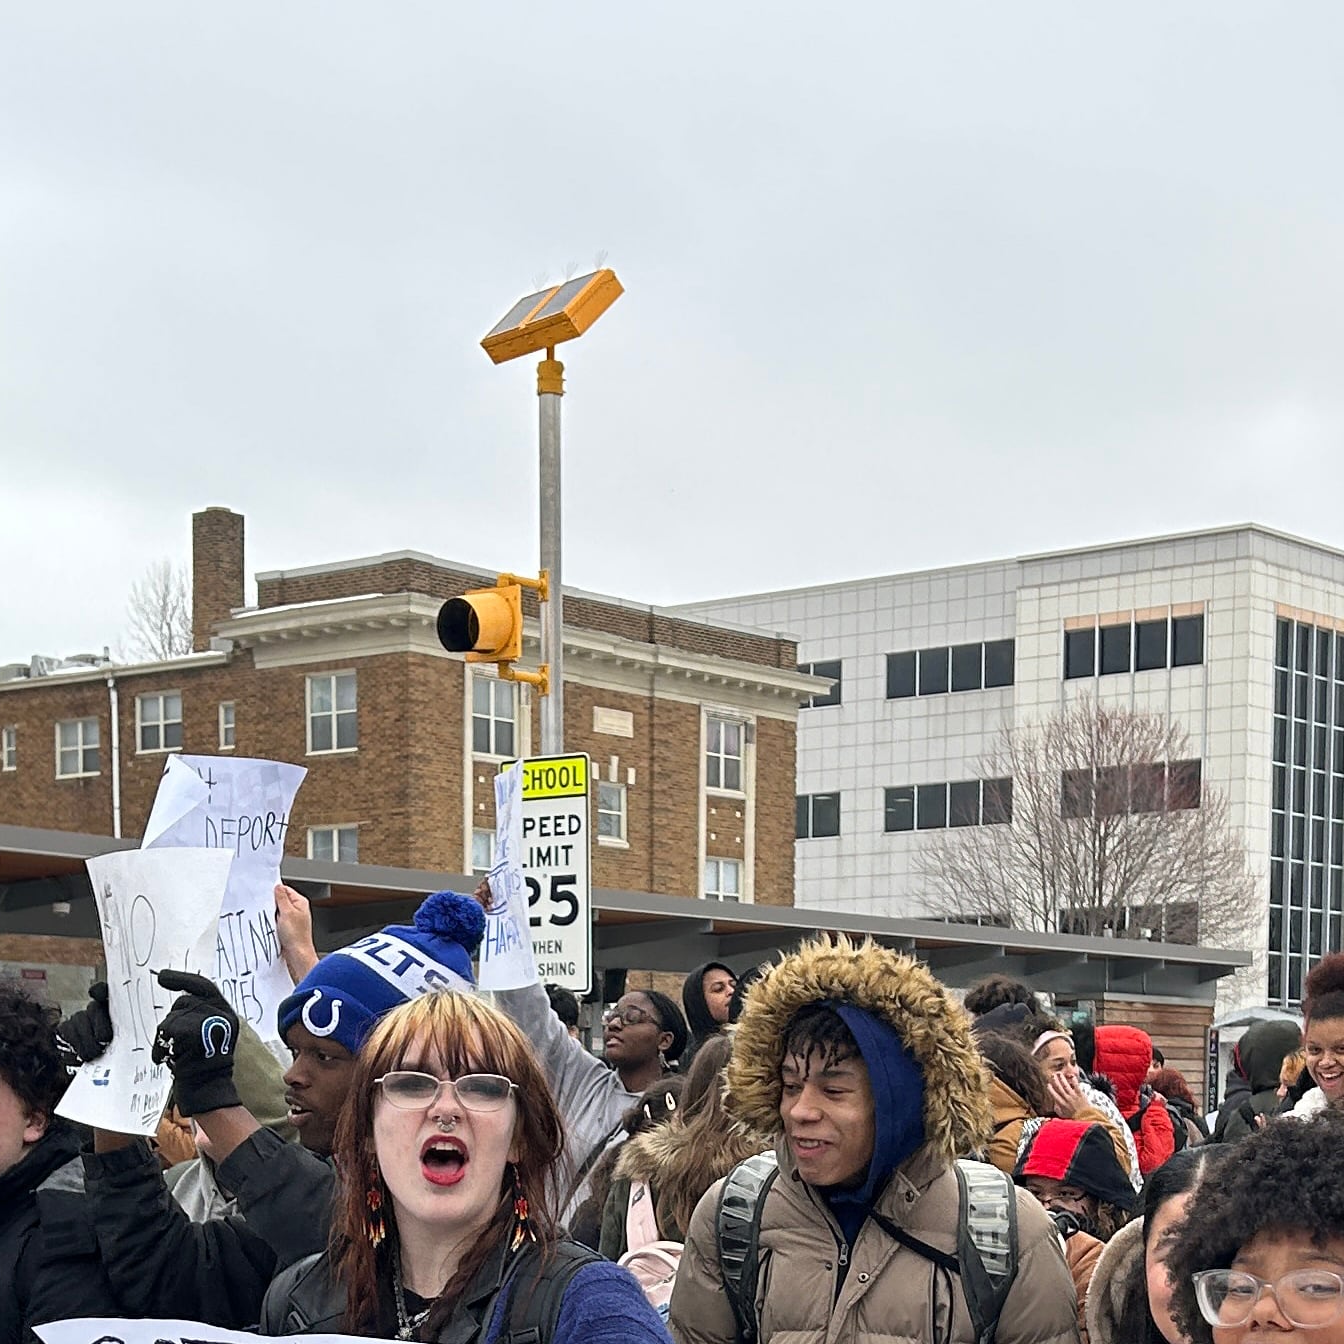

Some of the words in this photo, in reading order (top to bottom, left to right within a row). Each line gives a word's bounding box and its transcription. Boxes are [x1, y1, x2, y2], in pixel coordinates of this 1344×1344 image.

[521, 765, 583, 792] CHOOL
[522, 813, 582, 839] PEED
[522, 844, 574, 868] IMIT
[216, 908, 282, 979] ATINA
[538, 961, 576, 977] SHING
